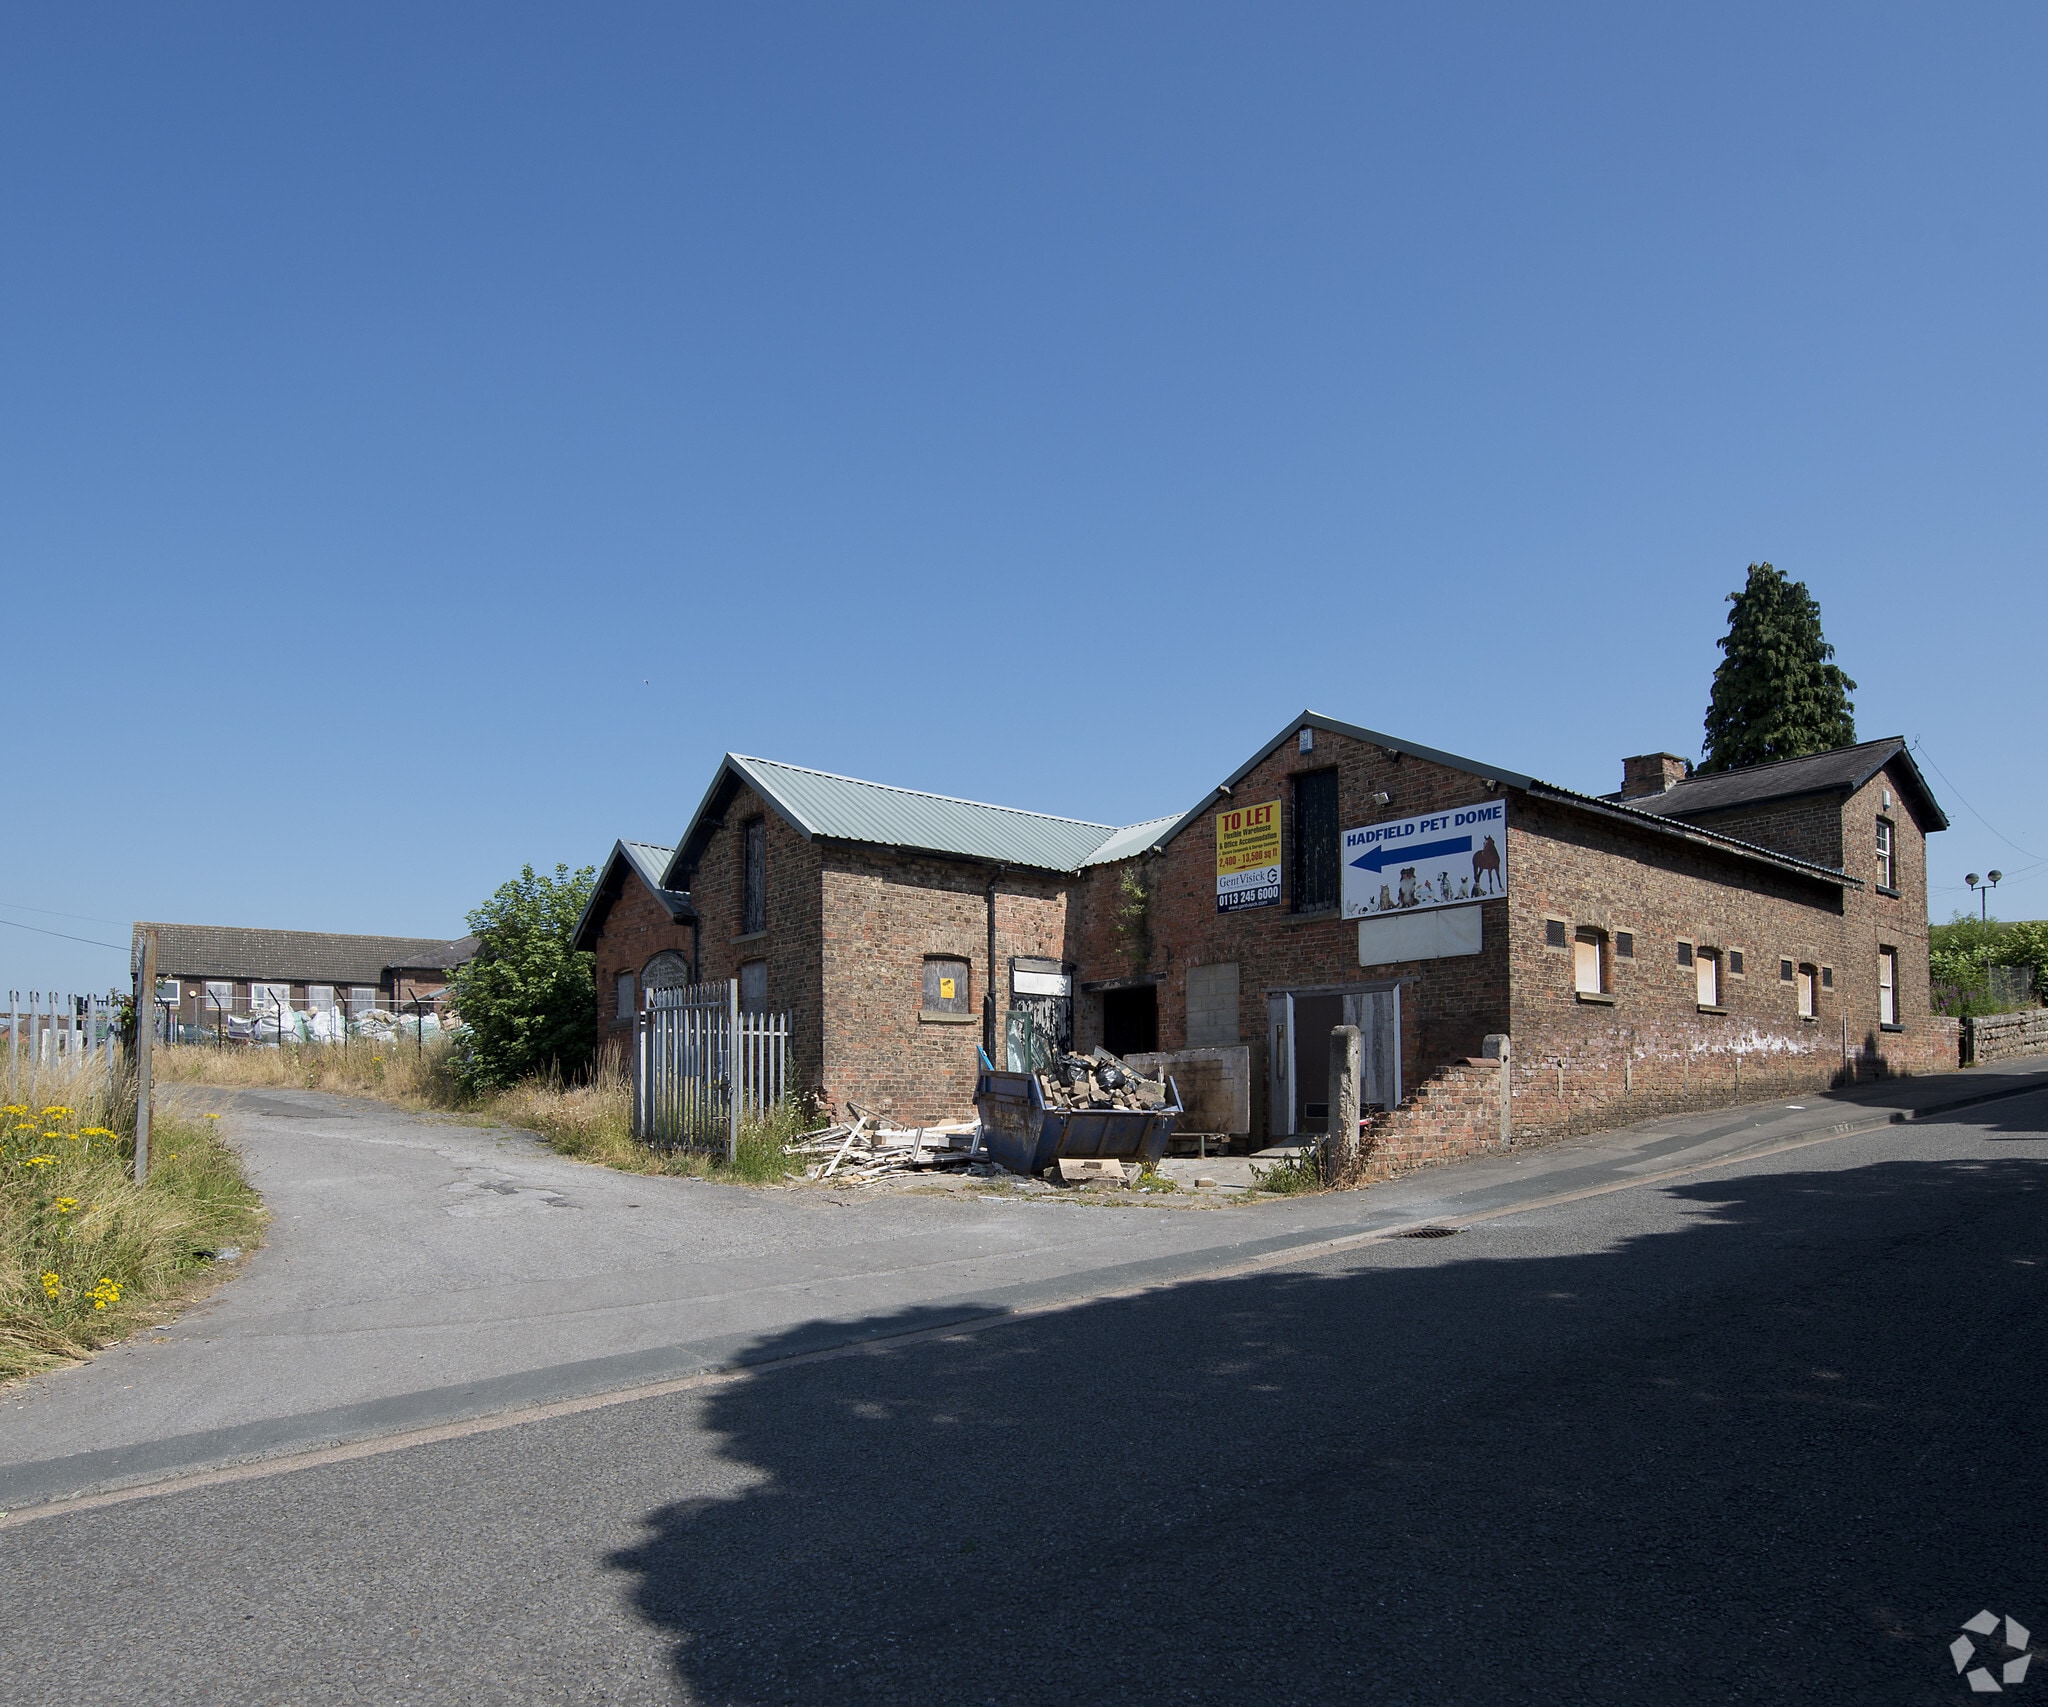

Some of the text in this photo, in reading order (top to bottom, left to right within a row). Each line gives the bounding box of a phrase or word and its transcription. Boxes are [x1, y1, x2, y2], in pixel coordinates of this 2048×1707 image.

[1222, 804, 1273, 832] TO LET
[1346, 806, 1503, 847] HADFIELD PET DOME
[1223, 824, 1272, 840] Flexible Warehouse
[1223, 840, 1238, 849] Office
[1239, 832, 1278, 846] Accommodation
[1218, 855, 1237, 868] 2,400
[1242, 850, 1263, 863] 13,500
[1263, 850, 1271, 859] sq
[1272, 847, 1278, 857] ft
[1219, 892, 1239, 907] 0113
[1240, 889, 1256, 903] 245
[1257, 885, 1279, 900] 6000
